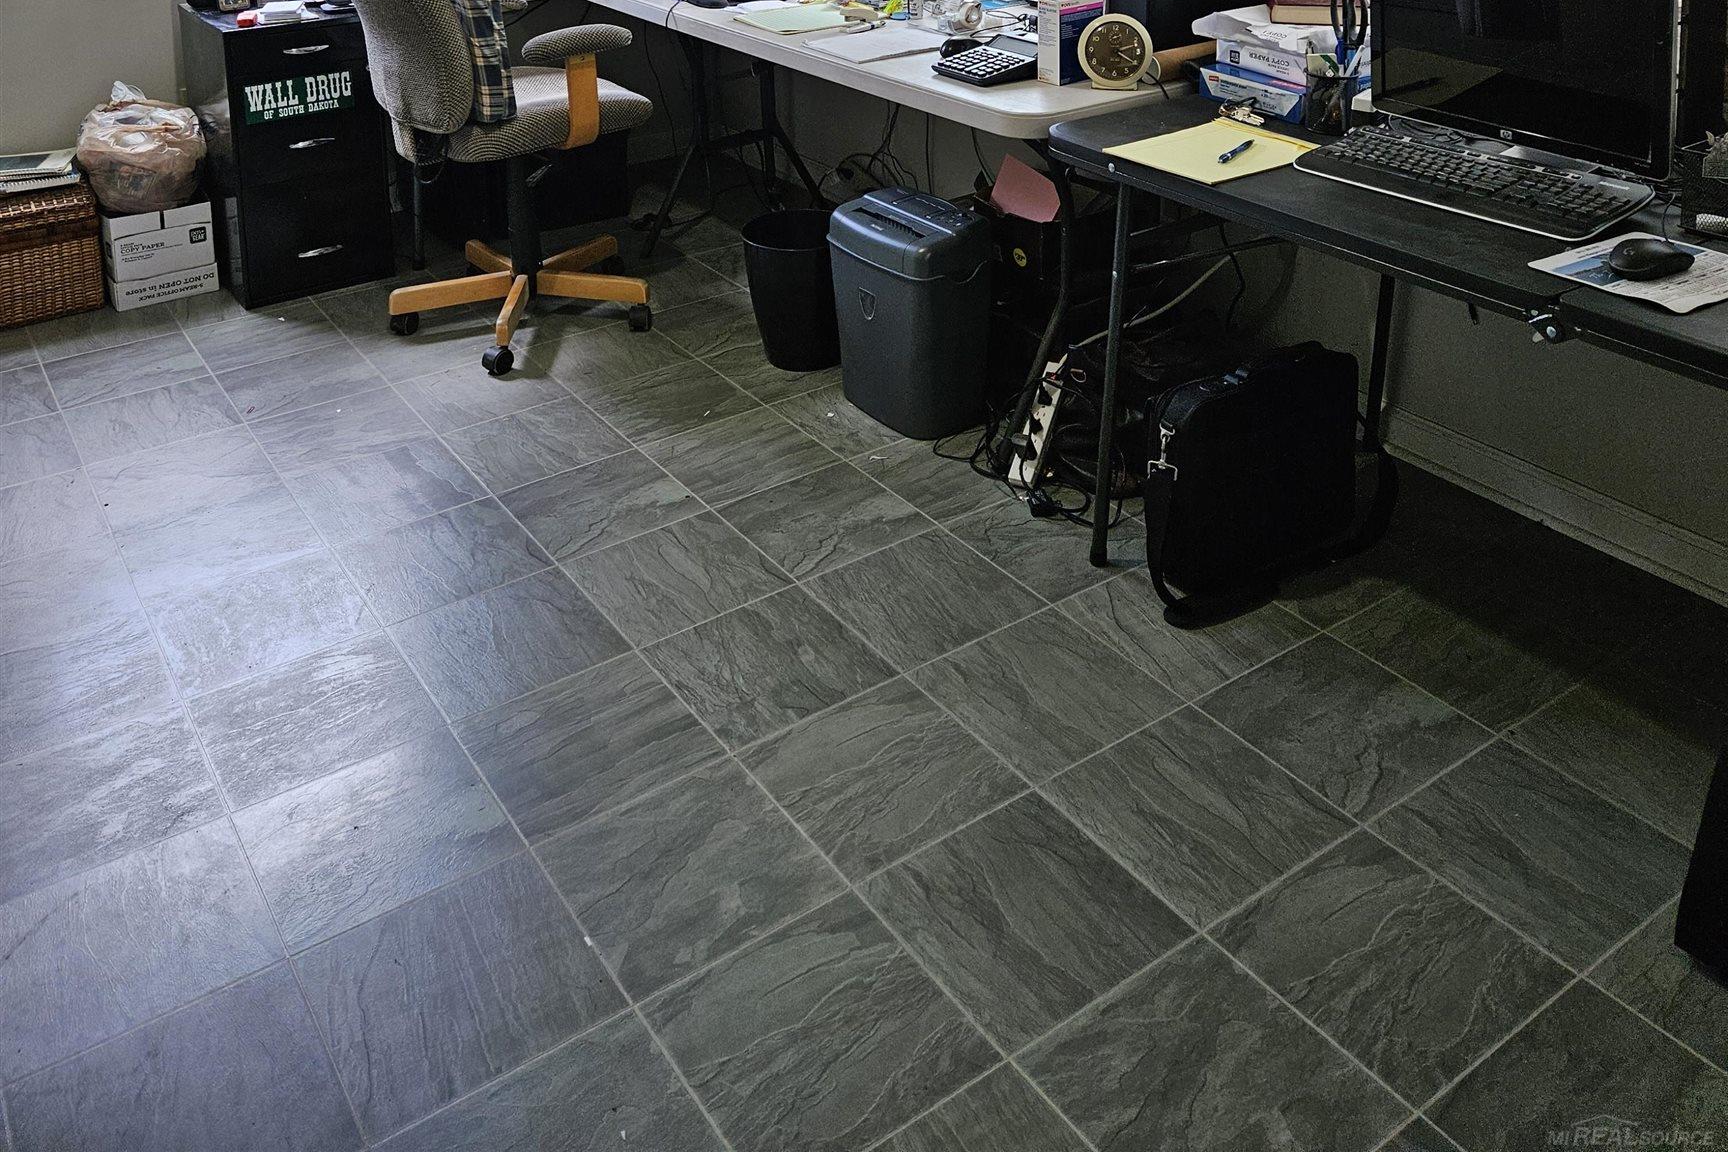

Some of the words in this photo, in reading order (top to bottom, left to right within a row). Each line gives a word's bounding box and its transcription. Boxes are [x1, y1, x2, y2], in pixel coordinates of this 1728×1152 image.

[1249, 52, 1269, 62] PAPER
[244, 80, 299, 112] WALL
[304, 71, 352, 102] DRUG
[264, 110, 274, 119] OF
[278, 105, 305, 117] SOUTH
[308, 100, 339, 112] DAKOTA
[142, 242, 165, 250] PAPER
[184, 275, 201, 284] NOT
[159, 280, 182, 289] OPEN
[139, 293, 155, 301] PACK
[156, 288, 178, 297] OFFICE
